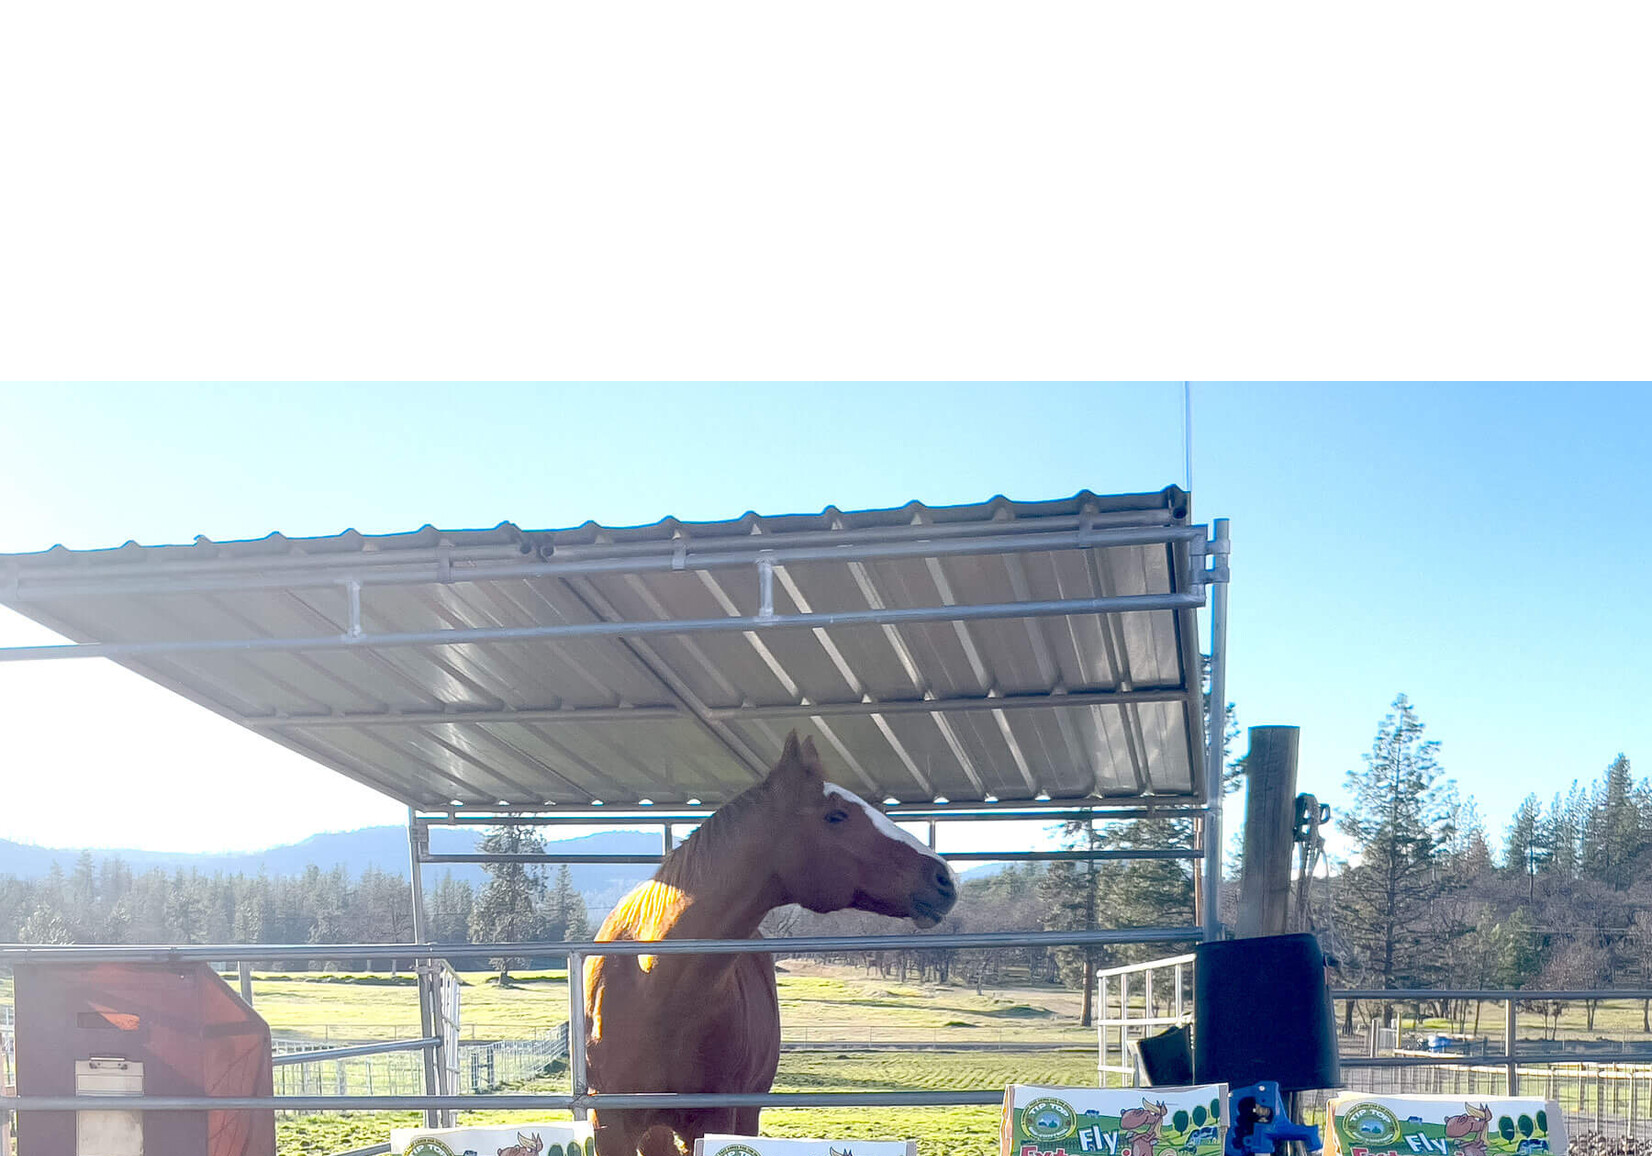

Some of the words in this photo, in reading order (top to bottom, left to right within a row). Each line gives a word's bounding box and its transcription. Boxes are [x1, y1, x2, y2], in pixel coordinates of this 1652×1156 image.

[1029, 1103, 1046, 1114] TIP
[1050, 1104, 1069, 1116] TOP
[1350, 1109, 1367, 1122] TIP
[1370, 1109, 1391, 1123] TOP
[1078, 1124, 1119, 1156] Fly
[1403, 1132, 1448, 1155] Fly
